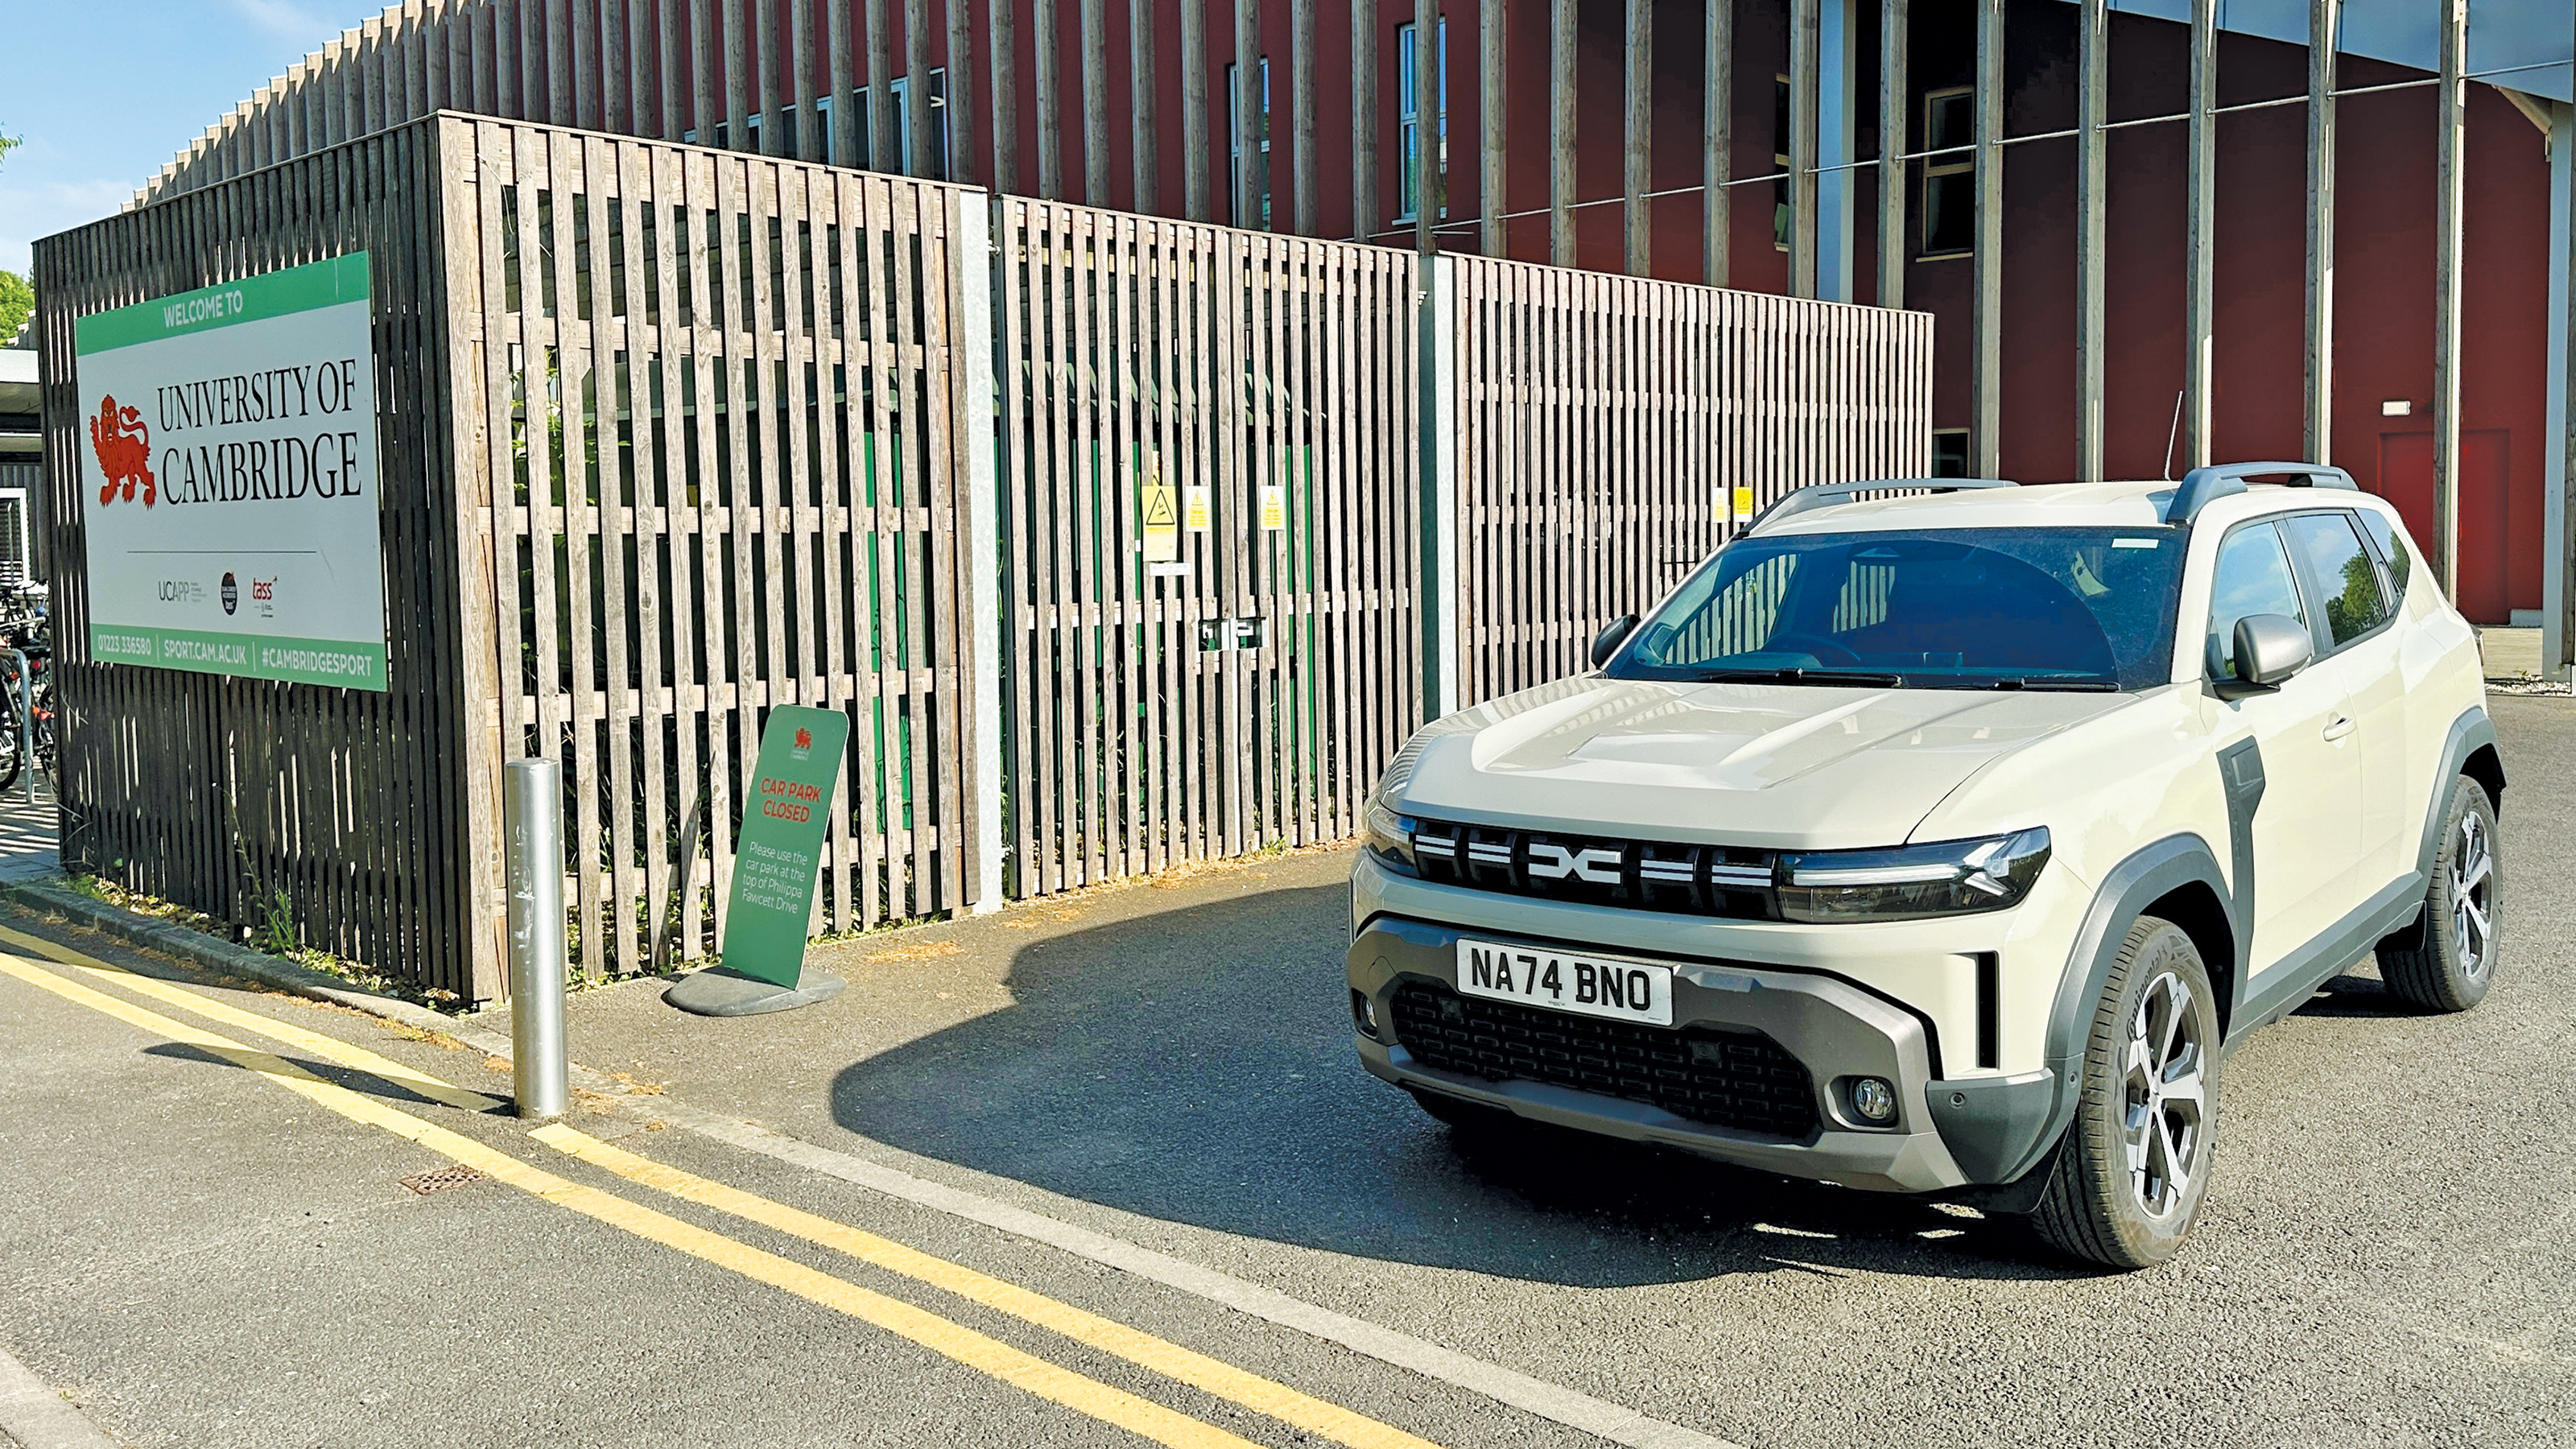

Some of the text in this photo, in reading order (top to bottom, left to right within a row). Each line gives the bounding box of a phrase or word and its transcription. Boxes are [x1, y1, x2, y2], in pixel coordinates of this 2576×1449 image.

[163, 290, 243, 328] WELCOME TO
[157, 359, 356, 432] UNIVERSITY OF
[162, 431, 361, 506] CAMBRIDGE
[158, 580, 189, 602] UCAPP
[252, 577, 272, 601] tass
[98, 634, 151, 656] 01223 336580
[164, 638, 247, 665] SPORT.CAM.AC.UK
[262, 647, 372, 677] #CAMBRIDGESPORT
[761, 778, 823, 803] CAR PARK
[763, 799, 810, 823] CLOSED
[749, 841, 808, 865] Please use the
[745, 859, 805, 882] car park at the
[743, 873, 803, 900] top of Philippa
[742, 888, 799, 914] Fawcett Drive
[1472, 947, 1652, 1012] NA74 BNO
